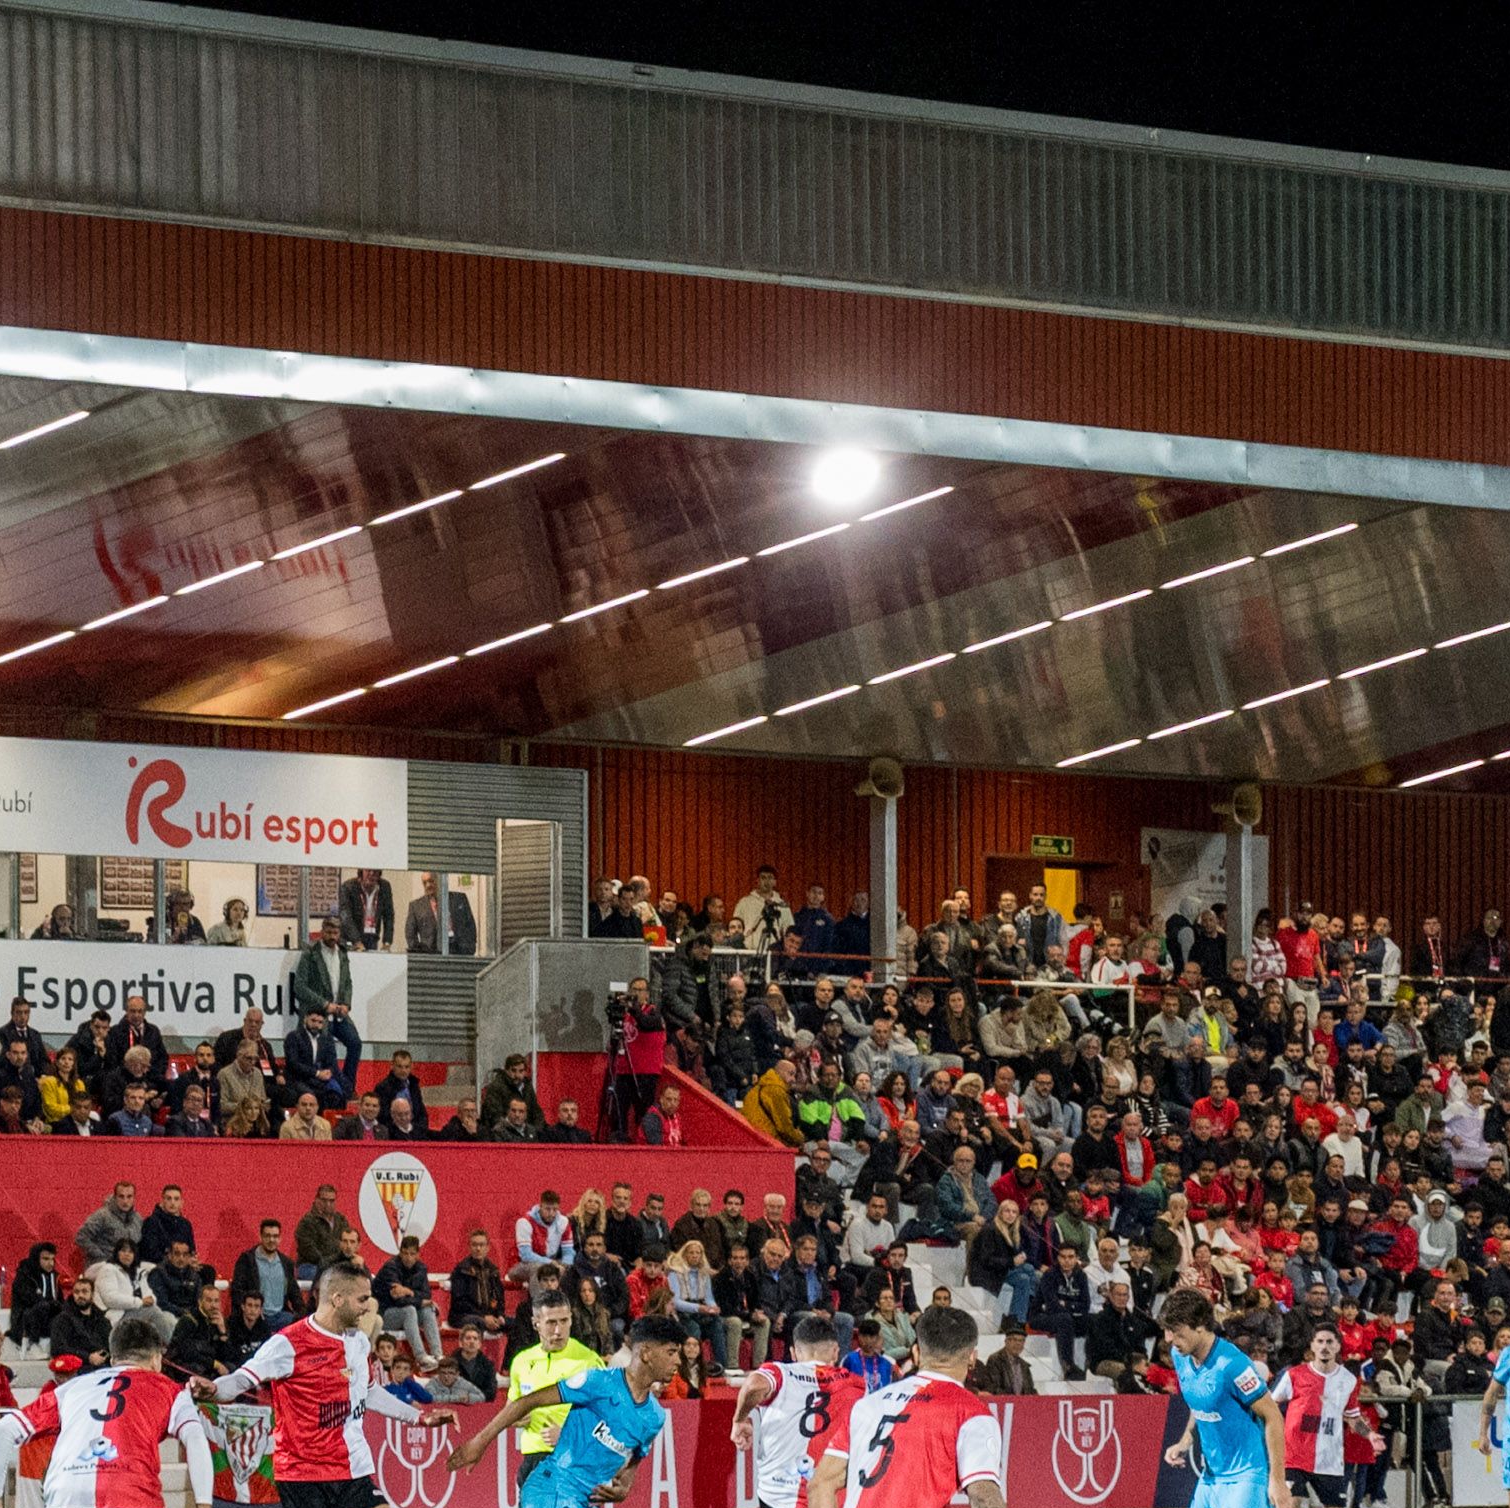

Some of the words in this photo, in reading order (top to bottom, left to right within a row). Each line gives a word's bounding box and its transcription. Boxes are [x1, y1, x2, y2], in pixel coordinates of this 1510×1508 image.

[125, 756, 254, 849] Rubí
[262, 812, 379, 855] esport
[17, 966, 215, 1021] Esportiva
[89, 1375, 132, 1422] 3
[799, 1391, 831, 1438] 8
[858, 1413, 911, 1488] 5
